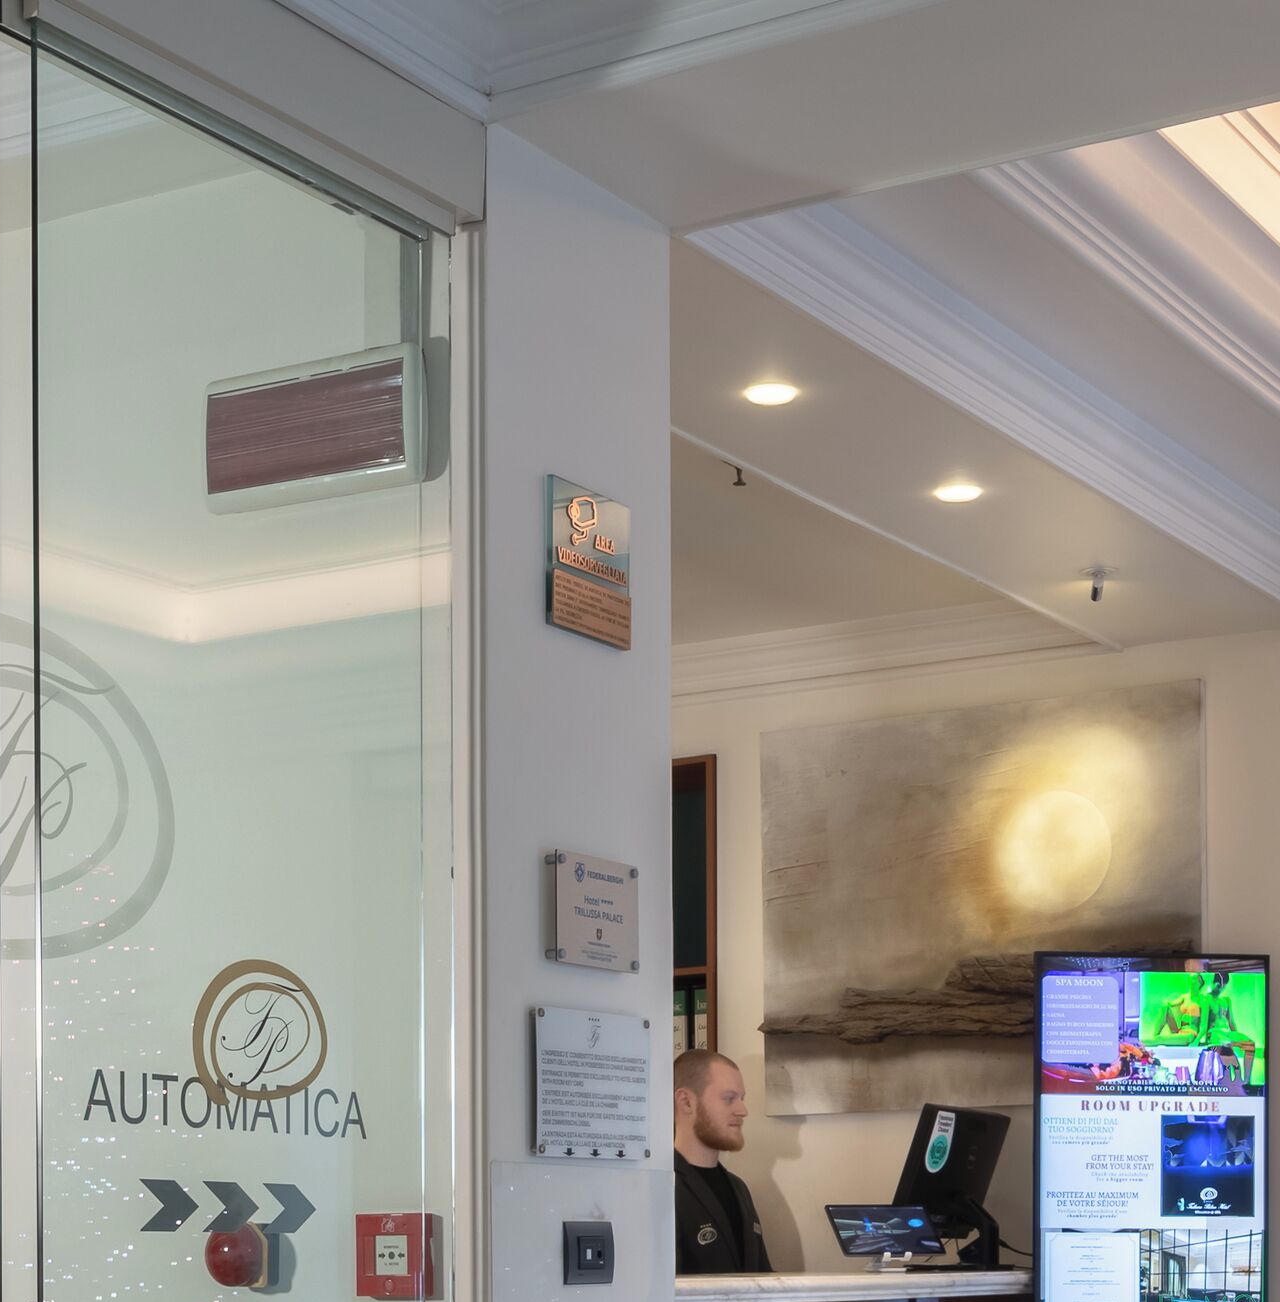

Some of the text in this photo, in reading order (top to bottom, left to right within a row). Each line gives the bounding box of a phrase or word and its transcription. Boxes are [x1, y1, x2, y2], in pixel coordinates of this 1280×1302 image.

[594, 534, 615, 555] AREA
[584, 895, 600, 906] Hotel
[574, 906, 623, 925] TRILUSSA PALACE
[1055, 978, 1072, 986] SPA
[83, 1069, 368, 1140] AUTOMATICA
[1080, 1099, 1220, 1112] ROOM UPGRADE
[1042, 1117, 1075, 1125] OTTIENI
[1076, 1117, 1086, 1125] DI
[1103, 1117, 1119, 1125] DAL
[1048, 1125, 1114, 1133] TUO SOGGIORNO
[1107, 1154, 1124, 1162] THE
[1125, 1154, 1149, 1162] MOST
[1085, 1162, 1154, 1170] FROM YOUR STAY!
[1045, 1190, 1139, 1199] PROFITEZ AU MAXIMUM
[1068, 1199, 1095, 1207] VOTRE
[1096, 1198, 1128, 1208] SÉJOUR!
